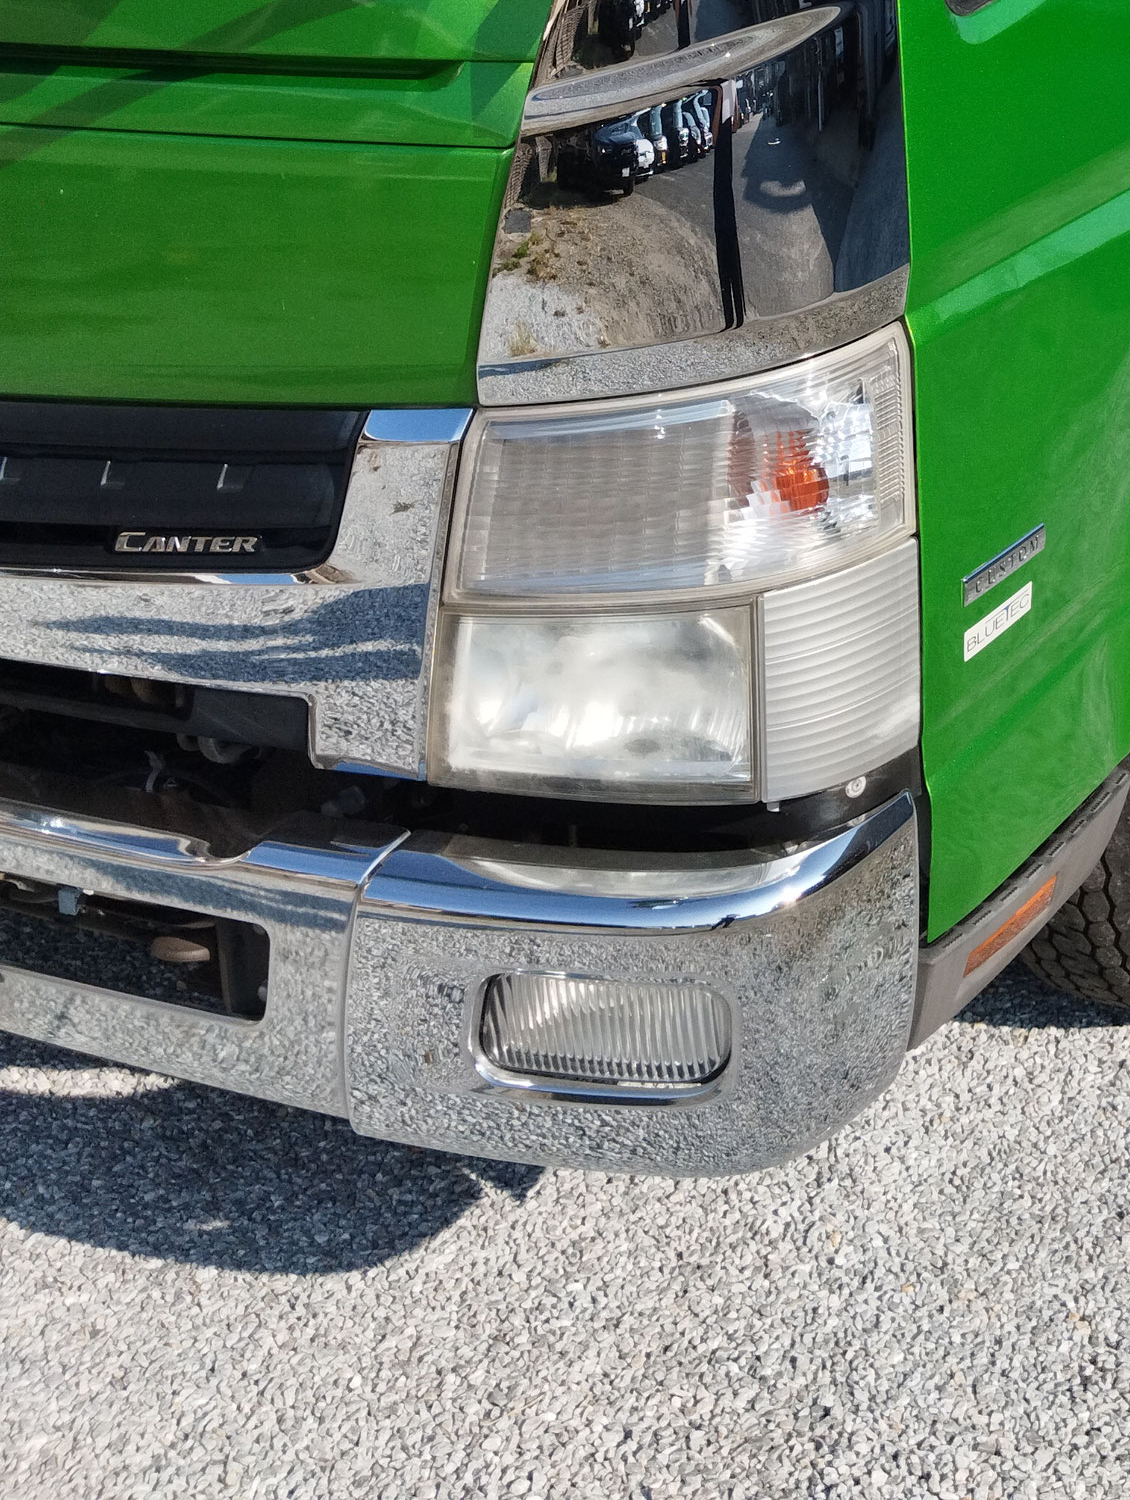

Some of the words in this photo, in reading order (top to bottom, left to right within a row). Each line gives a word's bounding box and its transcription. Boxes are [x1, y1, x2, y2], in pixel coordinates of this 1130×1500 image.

[114, 531, 257, 552] CANTER
[974, 534, 1040, 594] CUSTOM
[966, 588, 1030, 653] BLUETEC
